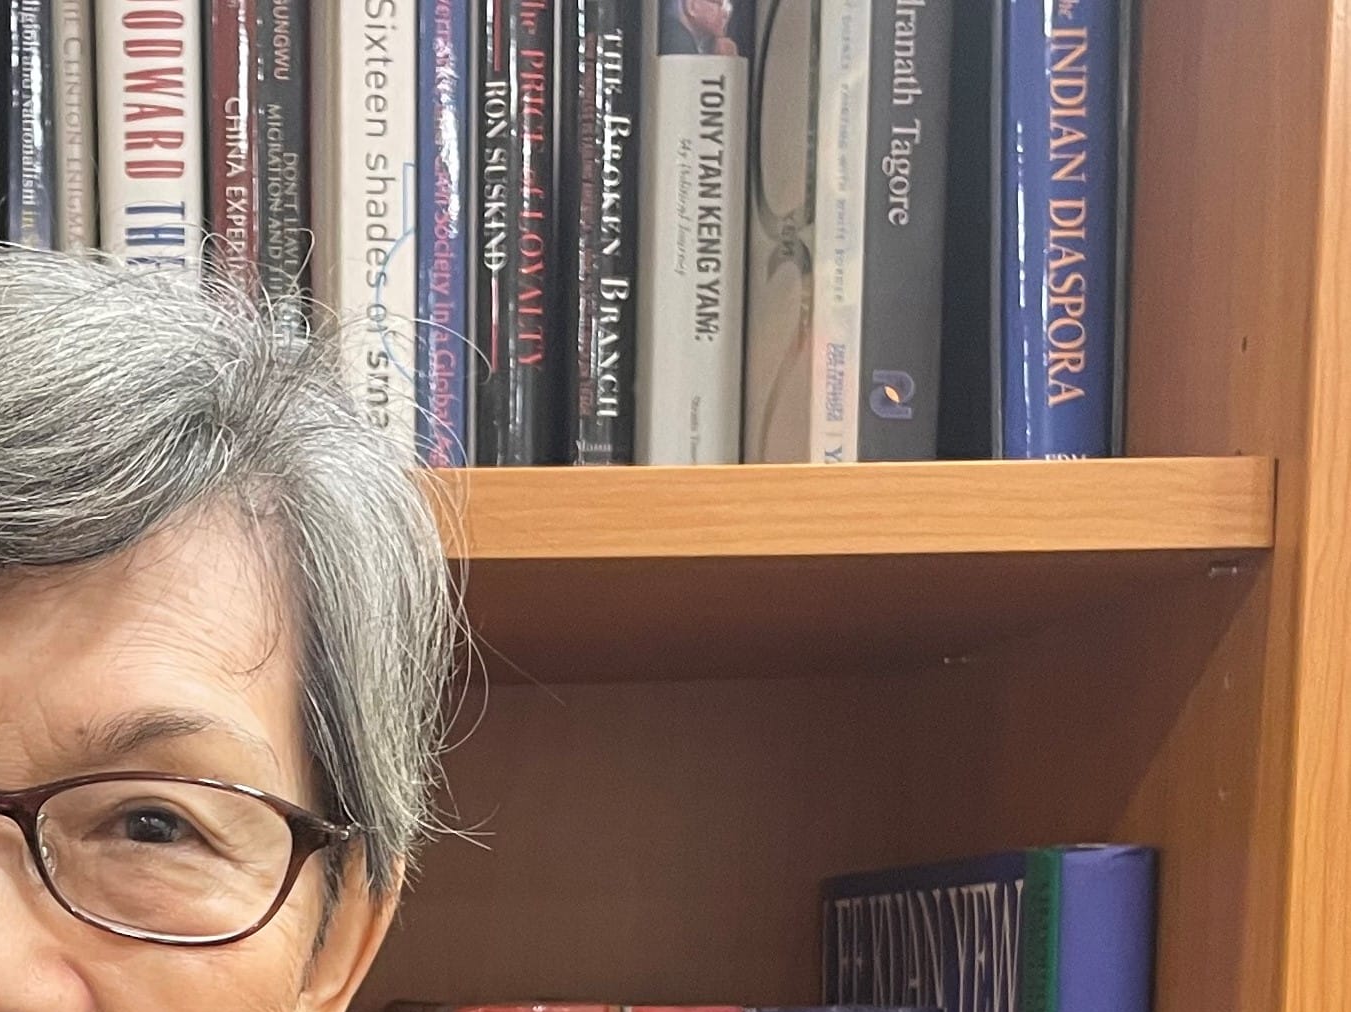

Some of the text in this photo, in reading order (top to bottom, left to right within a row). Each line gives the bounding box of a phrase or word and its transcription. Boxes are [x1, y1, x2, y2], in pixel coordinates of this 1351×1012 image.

[62, 37, 83, 147] CLINTON
[121, 0, 186, 180] ODWARD
[603, 29, 624, 96] THE
[1048, 27, 1088, 184] INDIAN
[224, 97, 247, 178] CHINA
[266, 103, 285, 260] MIGRATION AND
[282, 152, 300, 211] DON'T
[363, 0, 397, 289] Sixteen shades
[483, 80, 508, 272] RON SUSKIND
[600, 115, 633, 258] BROKEN
[694, 74, 726, 343] TONY TAN KENG YAM:
[883, 118, 922, 226] Tagore
[283, 217, 300, 267] LEAVE
[429, 210, 456, 295] Society
[518, 49, 546, 372] PRICE LOYALTY
[1048, 198, 1088, 408] DIASPORA
[433, 349, 458, 427] Global
